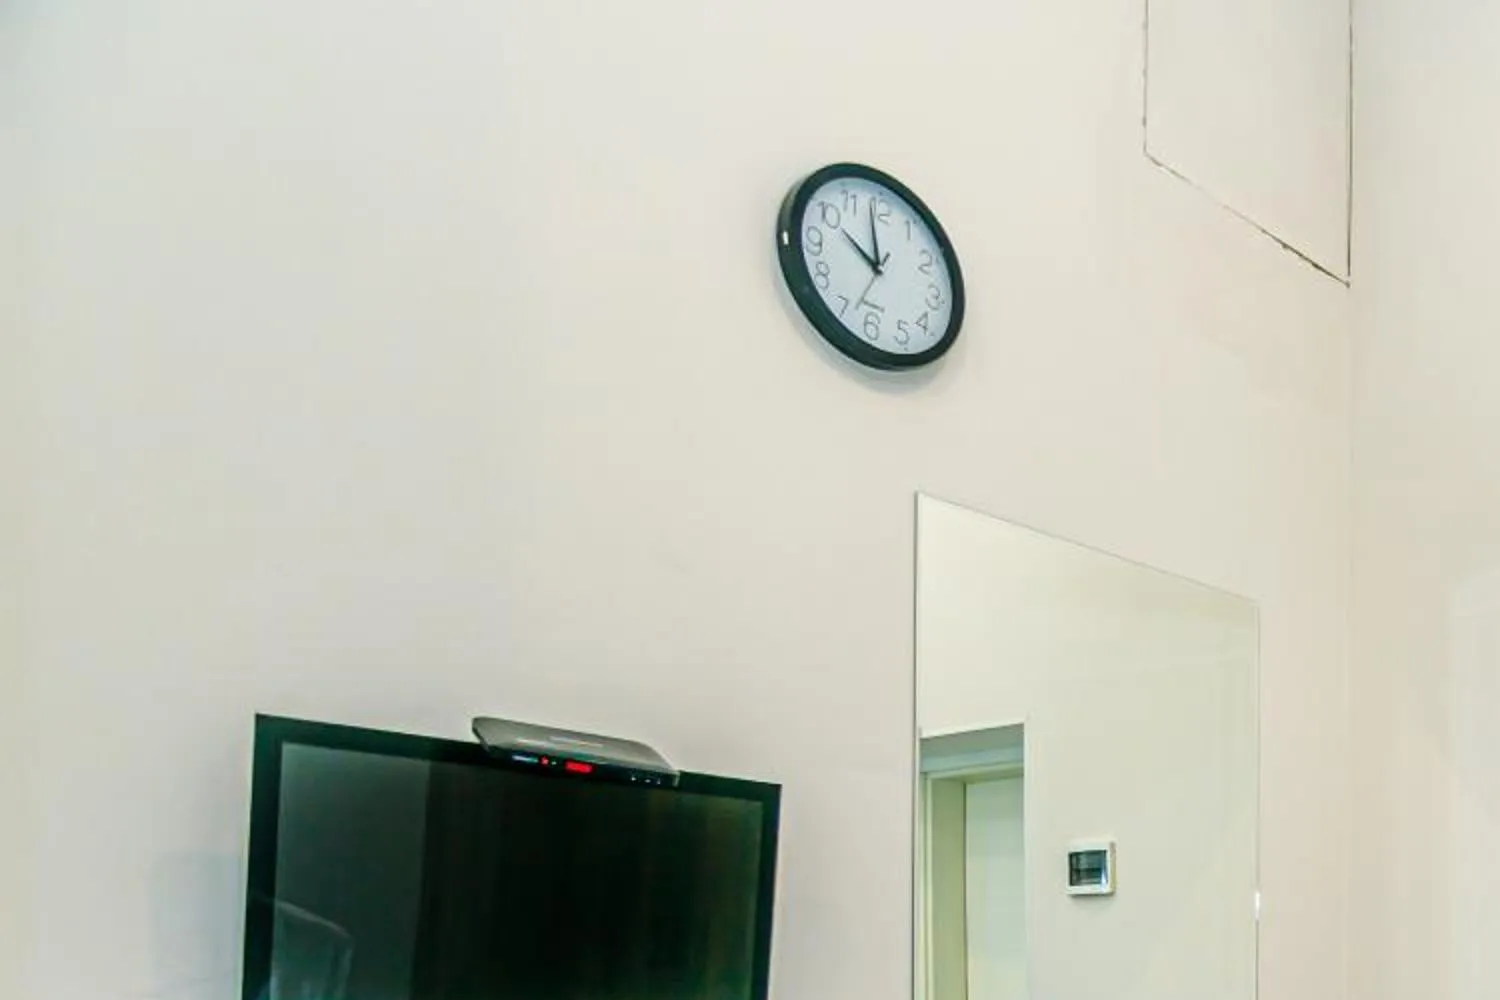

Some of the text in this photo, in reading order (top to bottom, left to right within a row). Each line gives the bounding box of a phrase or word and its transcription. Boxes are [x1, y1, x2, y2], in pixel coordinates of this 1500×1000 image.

[816, 201, 841, 229] 10
[840, 190, 857, 216] 11
[870, 197, 891, 225] 12
[806, 226, 823, 256] 9
[917, 249, 933, 275] 2
[814, 261, 830, 290] 8
[837, 295, 849, 318] 7
[925, 284, 942, 310] 3
[863, 312, 881, 341] 6
[894, 320, 910, 345] 5
[914, 312, 929, 336] 4
